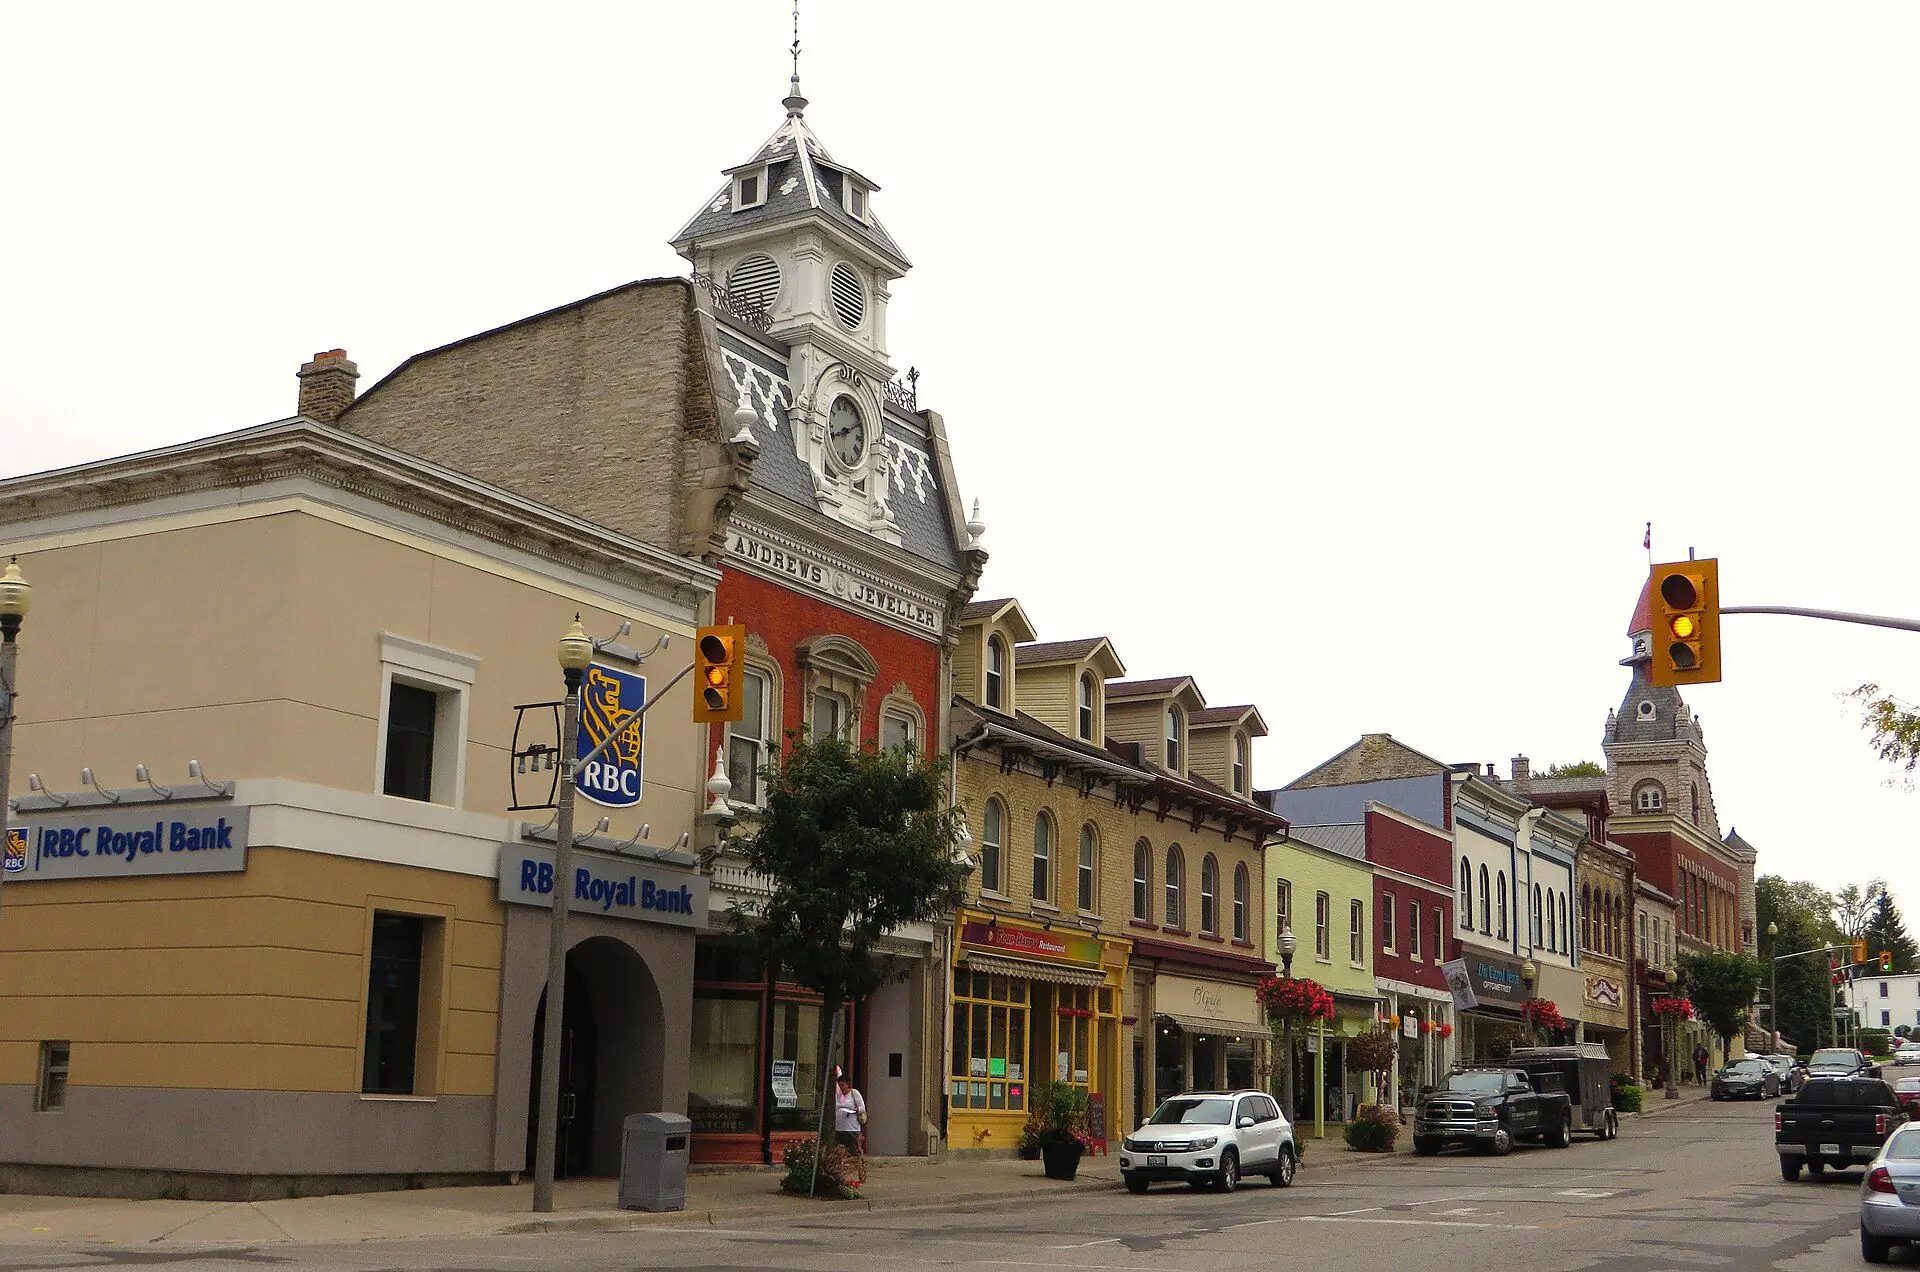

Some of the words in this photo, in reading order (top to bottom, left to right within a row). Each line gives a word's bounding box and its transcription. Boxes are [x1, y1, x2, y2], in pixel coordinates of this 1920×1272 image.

[735, 536, 822, 584] ANDREWS
[855, 585, 935, 628] JEWELLER
[583, 760, 638, 798] RBC
[43, 827, 91, 859] RBC
[96, 821, 163, 863] Royal
[169, 816, 233, 852] Bank
[5, 858, 24, 869] RBC
[521, 859, 556, 894] RB
[575, 868, 636, 911] Royal
[641, 879, 693, 915] Bank
[1038, 940, 1066, 953] Restaurant
